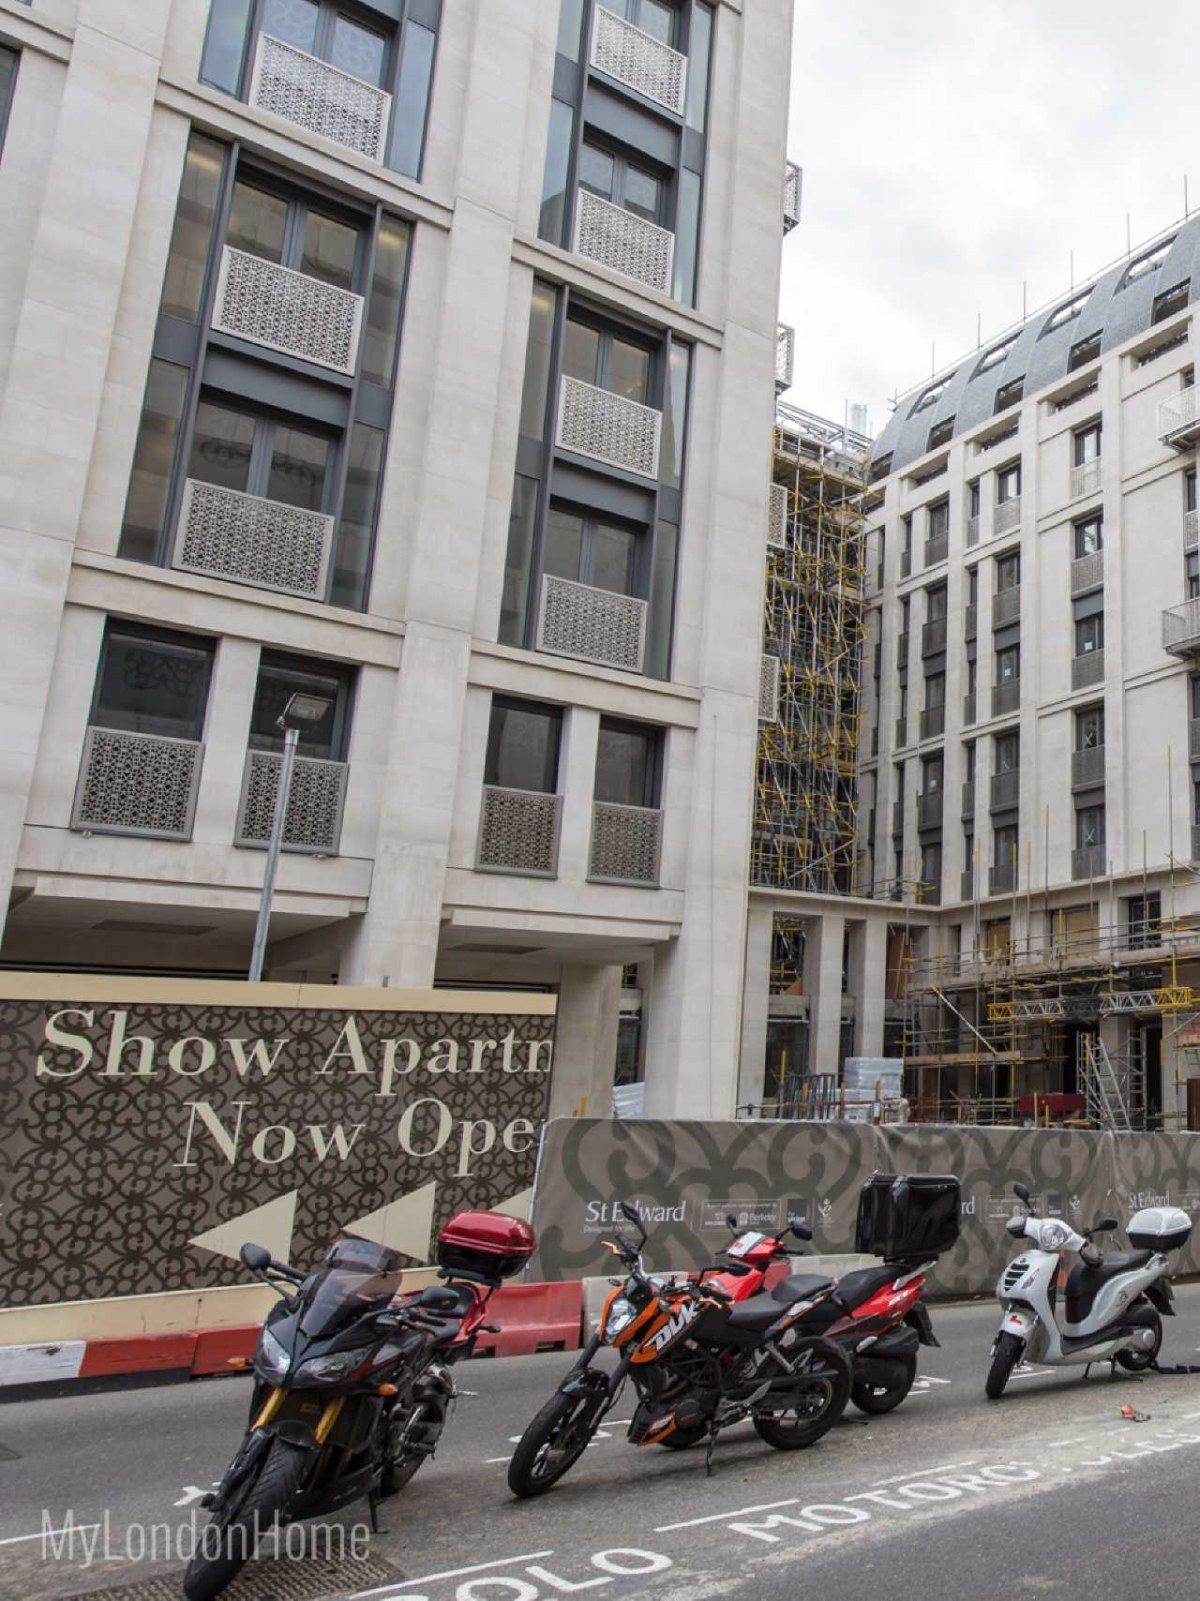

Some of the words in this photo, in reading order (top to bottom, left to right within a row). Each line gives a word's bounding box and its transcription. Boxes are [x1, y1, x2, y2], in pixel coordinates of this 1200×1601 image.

[37, 1008, 289, 1077] Show
[173, 1100, 365, 1168] Now
[398, 1097, 536, 1178] Ope
[585, 1200, 608, 1222] St
[612, 1199, 687, 1222] Eward
[380, 1547, 674, 1601] OLO
